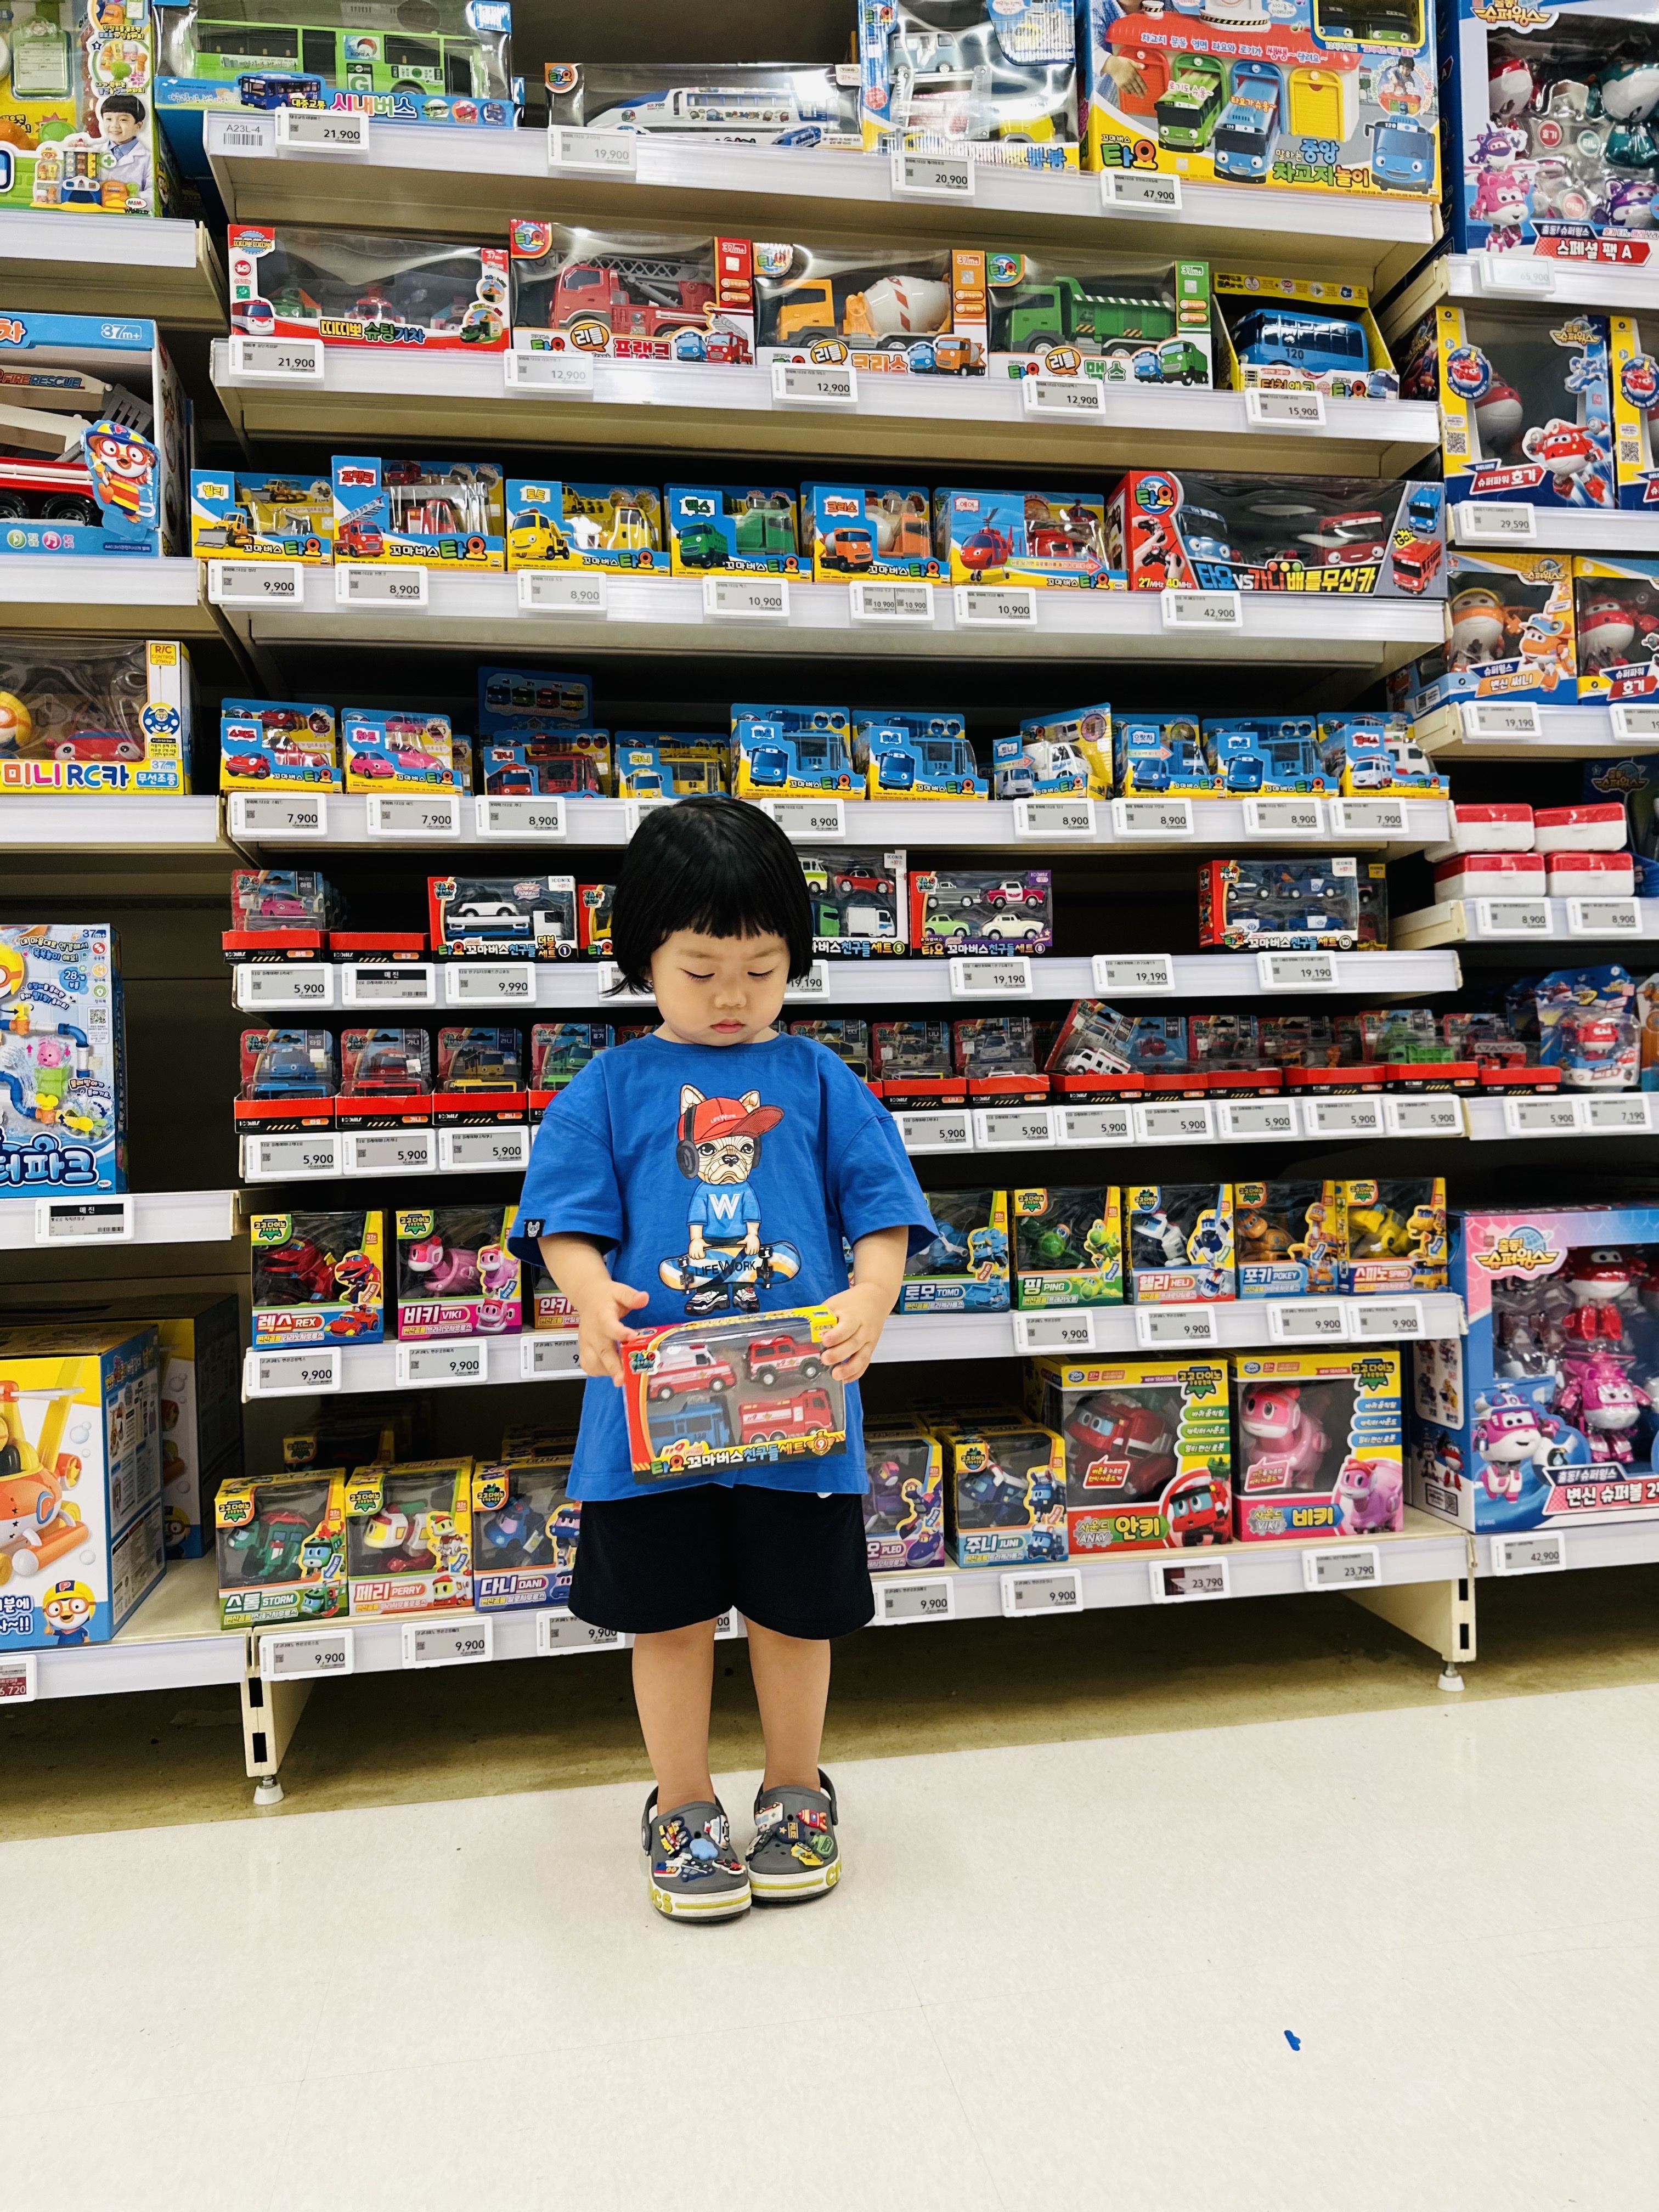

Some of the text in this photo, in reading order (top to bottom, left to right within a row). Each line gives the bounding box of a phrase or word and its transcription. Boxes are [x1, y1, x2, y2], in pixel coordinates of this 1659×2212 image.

[1479, 6, 1547, 27] 슈퍼윙스
[1141, 33, 1166, 45] 차고지
[1170, 35, 1187, 48] 문을
[1190, 39, 1208, 52] 열면
[1212, 41, 1237, 54] 타요와
[1239, 43, 1263, 55] 로기가
[292, 98, 326, 109] 대중교통
[330, 92, 417, 119] 시내버스
[324, 129, 360, 140] 21,900
[594, 149, 629, 160] 19,900
[1101, 139, 1159, 172] 타요
[1275, 138, 1339, 165] 말하는 중앙
[935, 174, 967, 184] 20,900
[1272, 161, 1369, 188] 차고지놀이
[1143, 190, 1175, 200] 47,900
[1542, 225, 1590, 236] 출동! 슈퍼윙스
[514, 231, 545, 246] 타요
[1557, 241, 1633, 259] 스페셜 팩 A
[988, 261, 1017, 277] 타요
[101, 323, 142, 341] 37m+
[1285, 348, 1304, 359] 120
[278, 357, 315, 368] 21,900
[851, 354, 909, 374] 크리스
[551, 370, 586, 381] 12,900
[817, 383, 850, 393] 12,900
[1067, 395, 1097, 405] 12,900
[1289, 407, 1318, 416] 15,900
[341, 469, 375, 484] 프랭크
[1477, 468, 1536, 488] 슈퍼파워 호기
[202, 484, 224, 499] 빌리
[685, 498, 710, 514] 맥스
[827, 500, 857, 514] 크리스
[1500, 519, 1529, 529] 29,590
[244, 537, 322, 557] 꼬마버스 타요
[390, 535, 488, 560] 꼬마버스 타요
[583, 550, 654, 570] 꼬마버스 타요
[263, 582, 295, 592] 9,900
[390, 585, 420, 595] 8,900
[571, 590, 600, 601] 8,900
[749, 596, 782, 607] 10,900
[998, 605, 1030, 615] 10,900
[1204, 608, 1235, 618] 42,900
[155, 645, 172, 654] R/C
[1483, 662, 1513, 676] 슈퍼윙스
[1616, 667, 1644, 679] 슈퍼파워
[1490, 673, 1533, 692] 변신 써니
[1622, 679, 1644, 695] 호기
[1505, 719, 1533, 727] 19,190
[357, 729, 376, 743] 하트
[494, 751, 514, 761] 가니
[631, 754, 651, 764] 라니
[138, 773, 177, 786] 무선조종
[287, 813, 318, 825] 7,900
[421, 815, 452, 826] 7,900
[529, 816, 558, 826] 8,900
[811, 817, 838, 827] 8,900
[1063, 816, 1088, 826] 8,900
[1161, 816, 1186, 825] 8,900
[83, 929, 106, 938] 37m+
[20, 936, 89, 951] 내 마음대로 연결해서
[994, 974, 1025, 985] 19,190
[1136, 972, 1167, 983] 19,190
[1301, 968, 1331, 979] 19,190
[294, 984, 324, 994] 5,900
[499, 983, 528, 992] 9,990
[1622, 1113, 1645, 1122] 7,190
[939, 1128, 966, 1138] 5,900
[1022, 1126, 1048, 1136] 5,900
[397, 1149, 427, 1161] 5,900
[493, 1146, 521, 1156] 5,900
[303, 1154, 334, 1165] 5,900
[709, 1194, 741, 1220] W
[695, 1260, 757, 1277] LIFEWORK
[1243, 1267, 1297, 1286] 포키 POKEY
[1354, 1266, 1409, 1284] 스피노 SPINO
[1023, 1277, 1065, 1296] 핑 PING
[1138, 1273, 1190, 1292] 헬리 HELI
[904, 1284, 960, 1301] 토모 TOMO
[404, 1305, 462, 1325] 비키 VIKI
[258, 1314, 317, 1332] 렉스 REX
[1316, 1319, 1341, 1330] 9,900
[1393, 1319, 1418, 1329] 9,900
[1062, 1329, 1088, 1340] 9,900
[1184, 1325, 1210, 1335] 9,900
[450, 1360, 479, 1373] 9,900
[1352, 1362, 1395, 1373] 고고다이노
[301, 1369, 332, 1381] 9,900
[1179, 1370, 1222, 1381] 고고다이노
[650, 1457, 685, 1475] 타요
[687, 1452, 744, 1469] 꼬마버스
[743, 1446, 780, 1464] 친구들
[779, 1441, 806, 1455] 세트
[1558, 1466, 1617, 1483] 출동! 슈퍼윙스
[1566, 1483, 1643, 1509] 변신 슈퍼볼
[1253, 1508, 1282, 1520] 사운드
[1292, 1506, 1334, 1527] 비키
[1079, 1519, 1109, 1532] 사운드
[1114, 1516, 1160, 1541] 안키
[966, 1534, 1019, 1553] 주니 JUNI
[1079, 1532, 1108, 1544] ANKY
[882, 1545, 902, 1554] PLEO
[1531, 1551, 1559, 1562] 42,900
[1344, 1565, 1374, 1578] 23,790
[479, 1575, 544, 1596] 다니 DANI
[1192, 1577, 1223, 1590] 23,790
[354, 1583, 422, 1602] 페리 PERRY
[1049, 1591, 1076, 1602] 9,900
[225, 1593, 295, 1612] 스톰 STORM
[921, 1599, 947, 1611] 9,900
[455, 1639, 485, 1652] 9,900
[315, 1652, 345, 1667] 9,900
